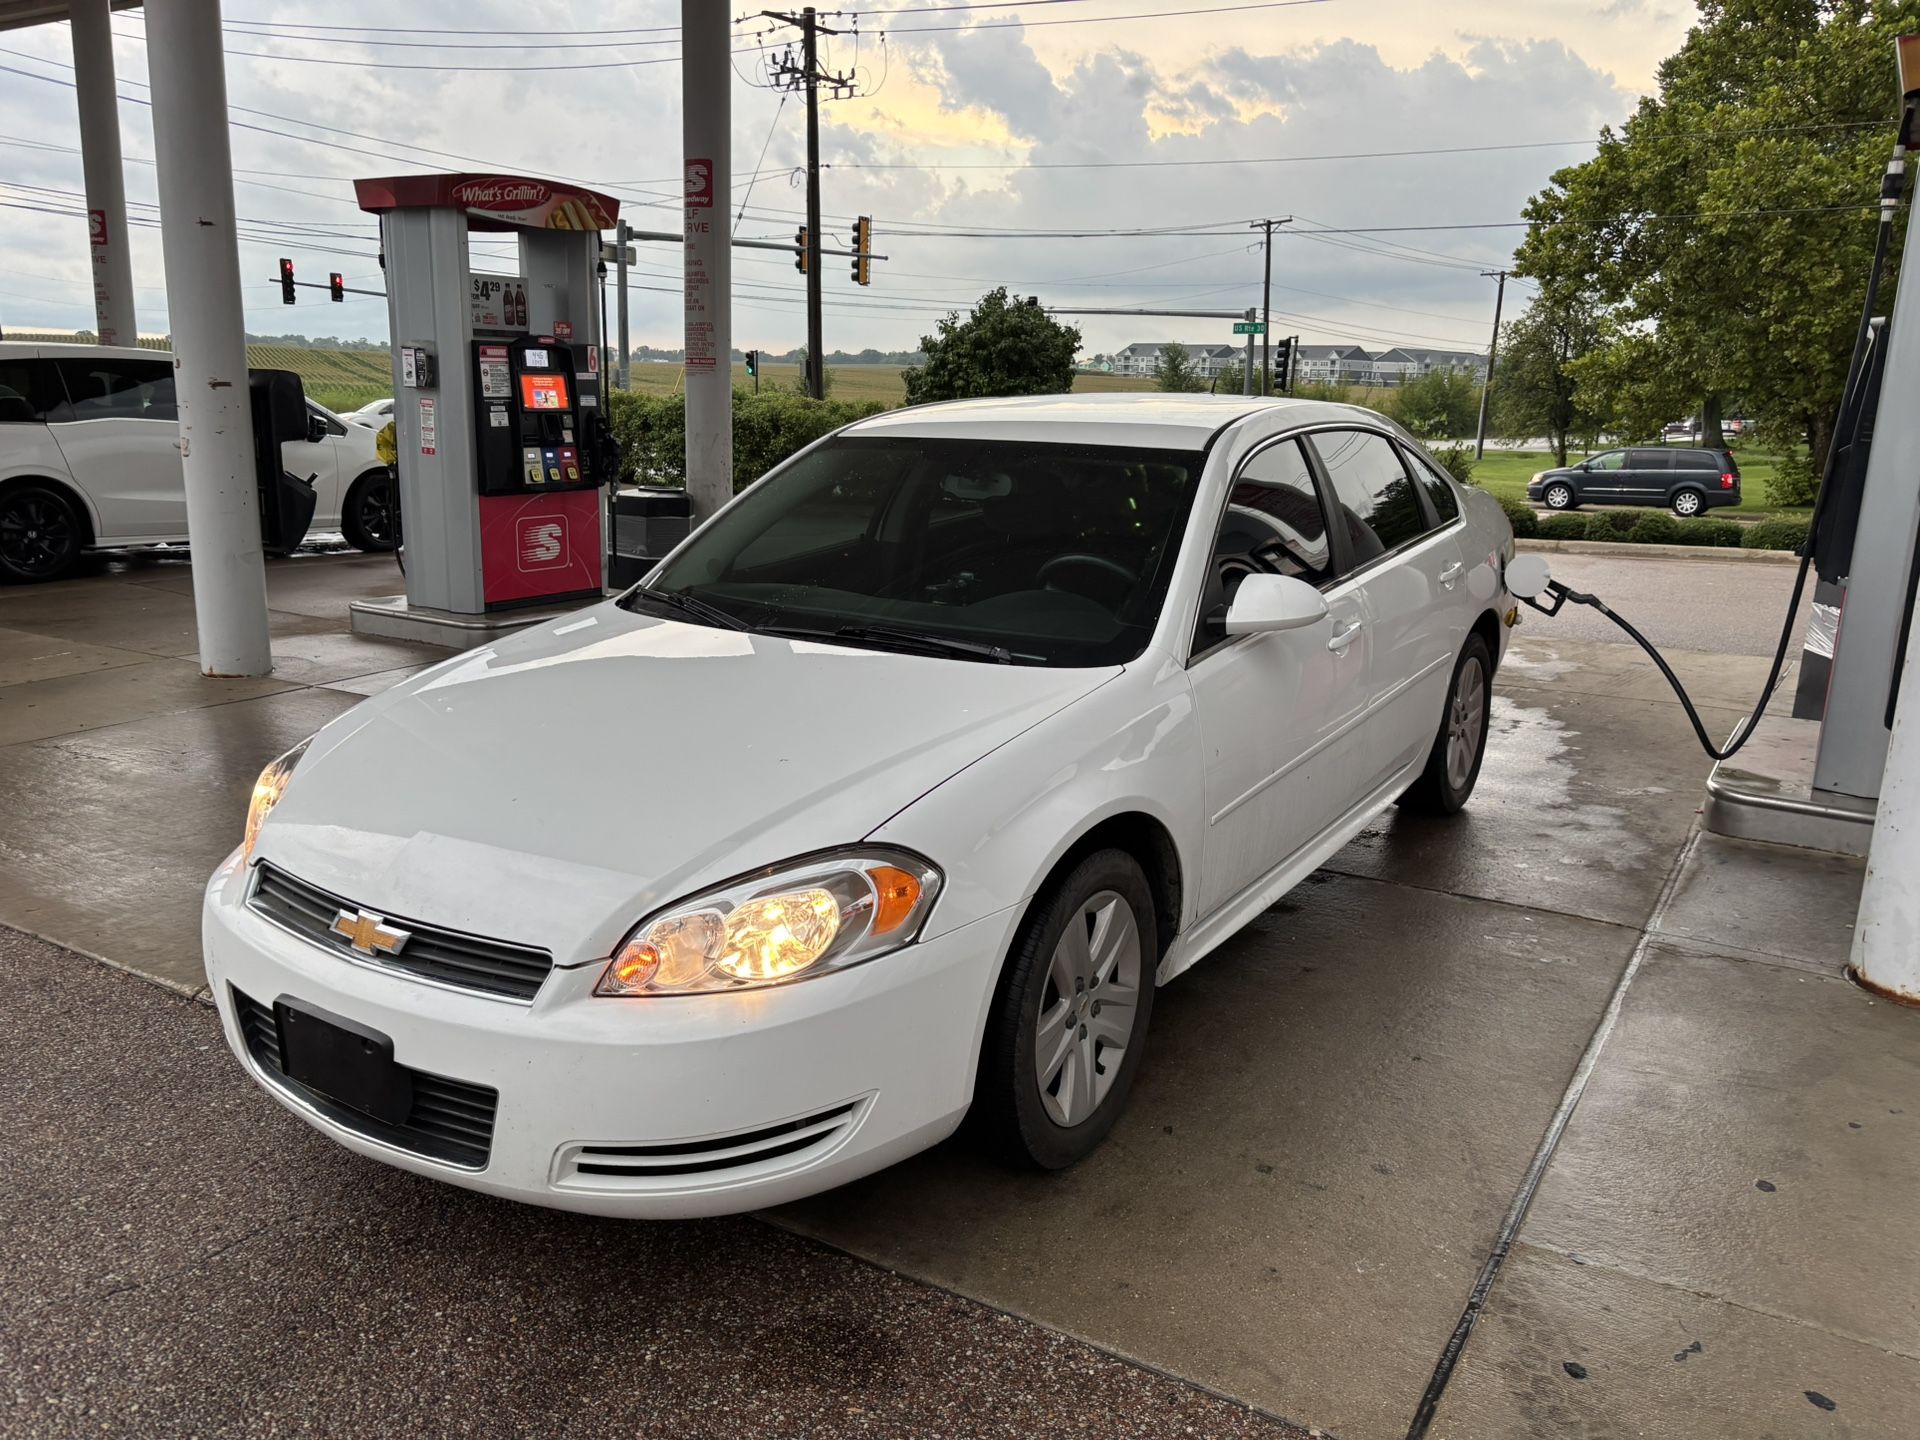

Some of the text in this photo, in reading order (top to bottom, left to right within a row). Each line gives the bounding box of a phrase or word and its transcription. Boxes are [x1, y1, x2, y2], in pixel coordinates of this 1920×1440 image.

[461, 185, 545, 201] What's Grillin'?
[589, 347, 597, 372] 6
[525, 523, 562, 563] S
